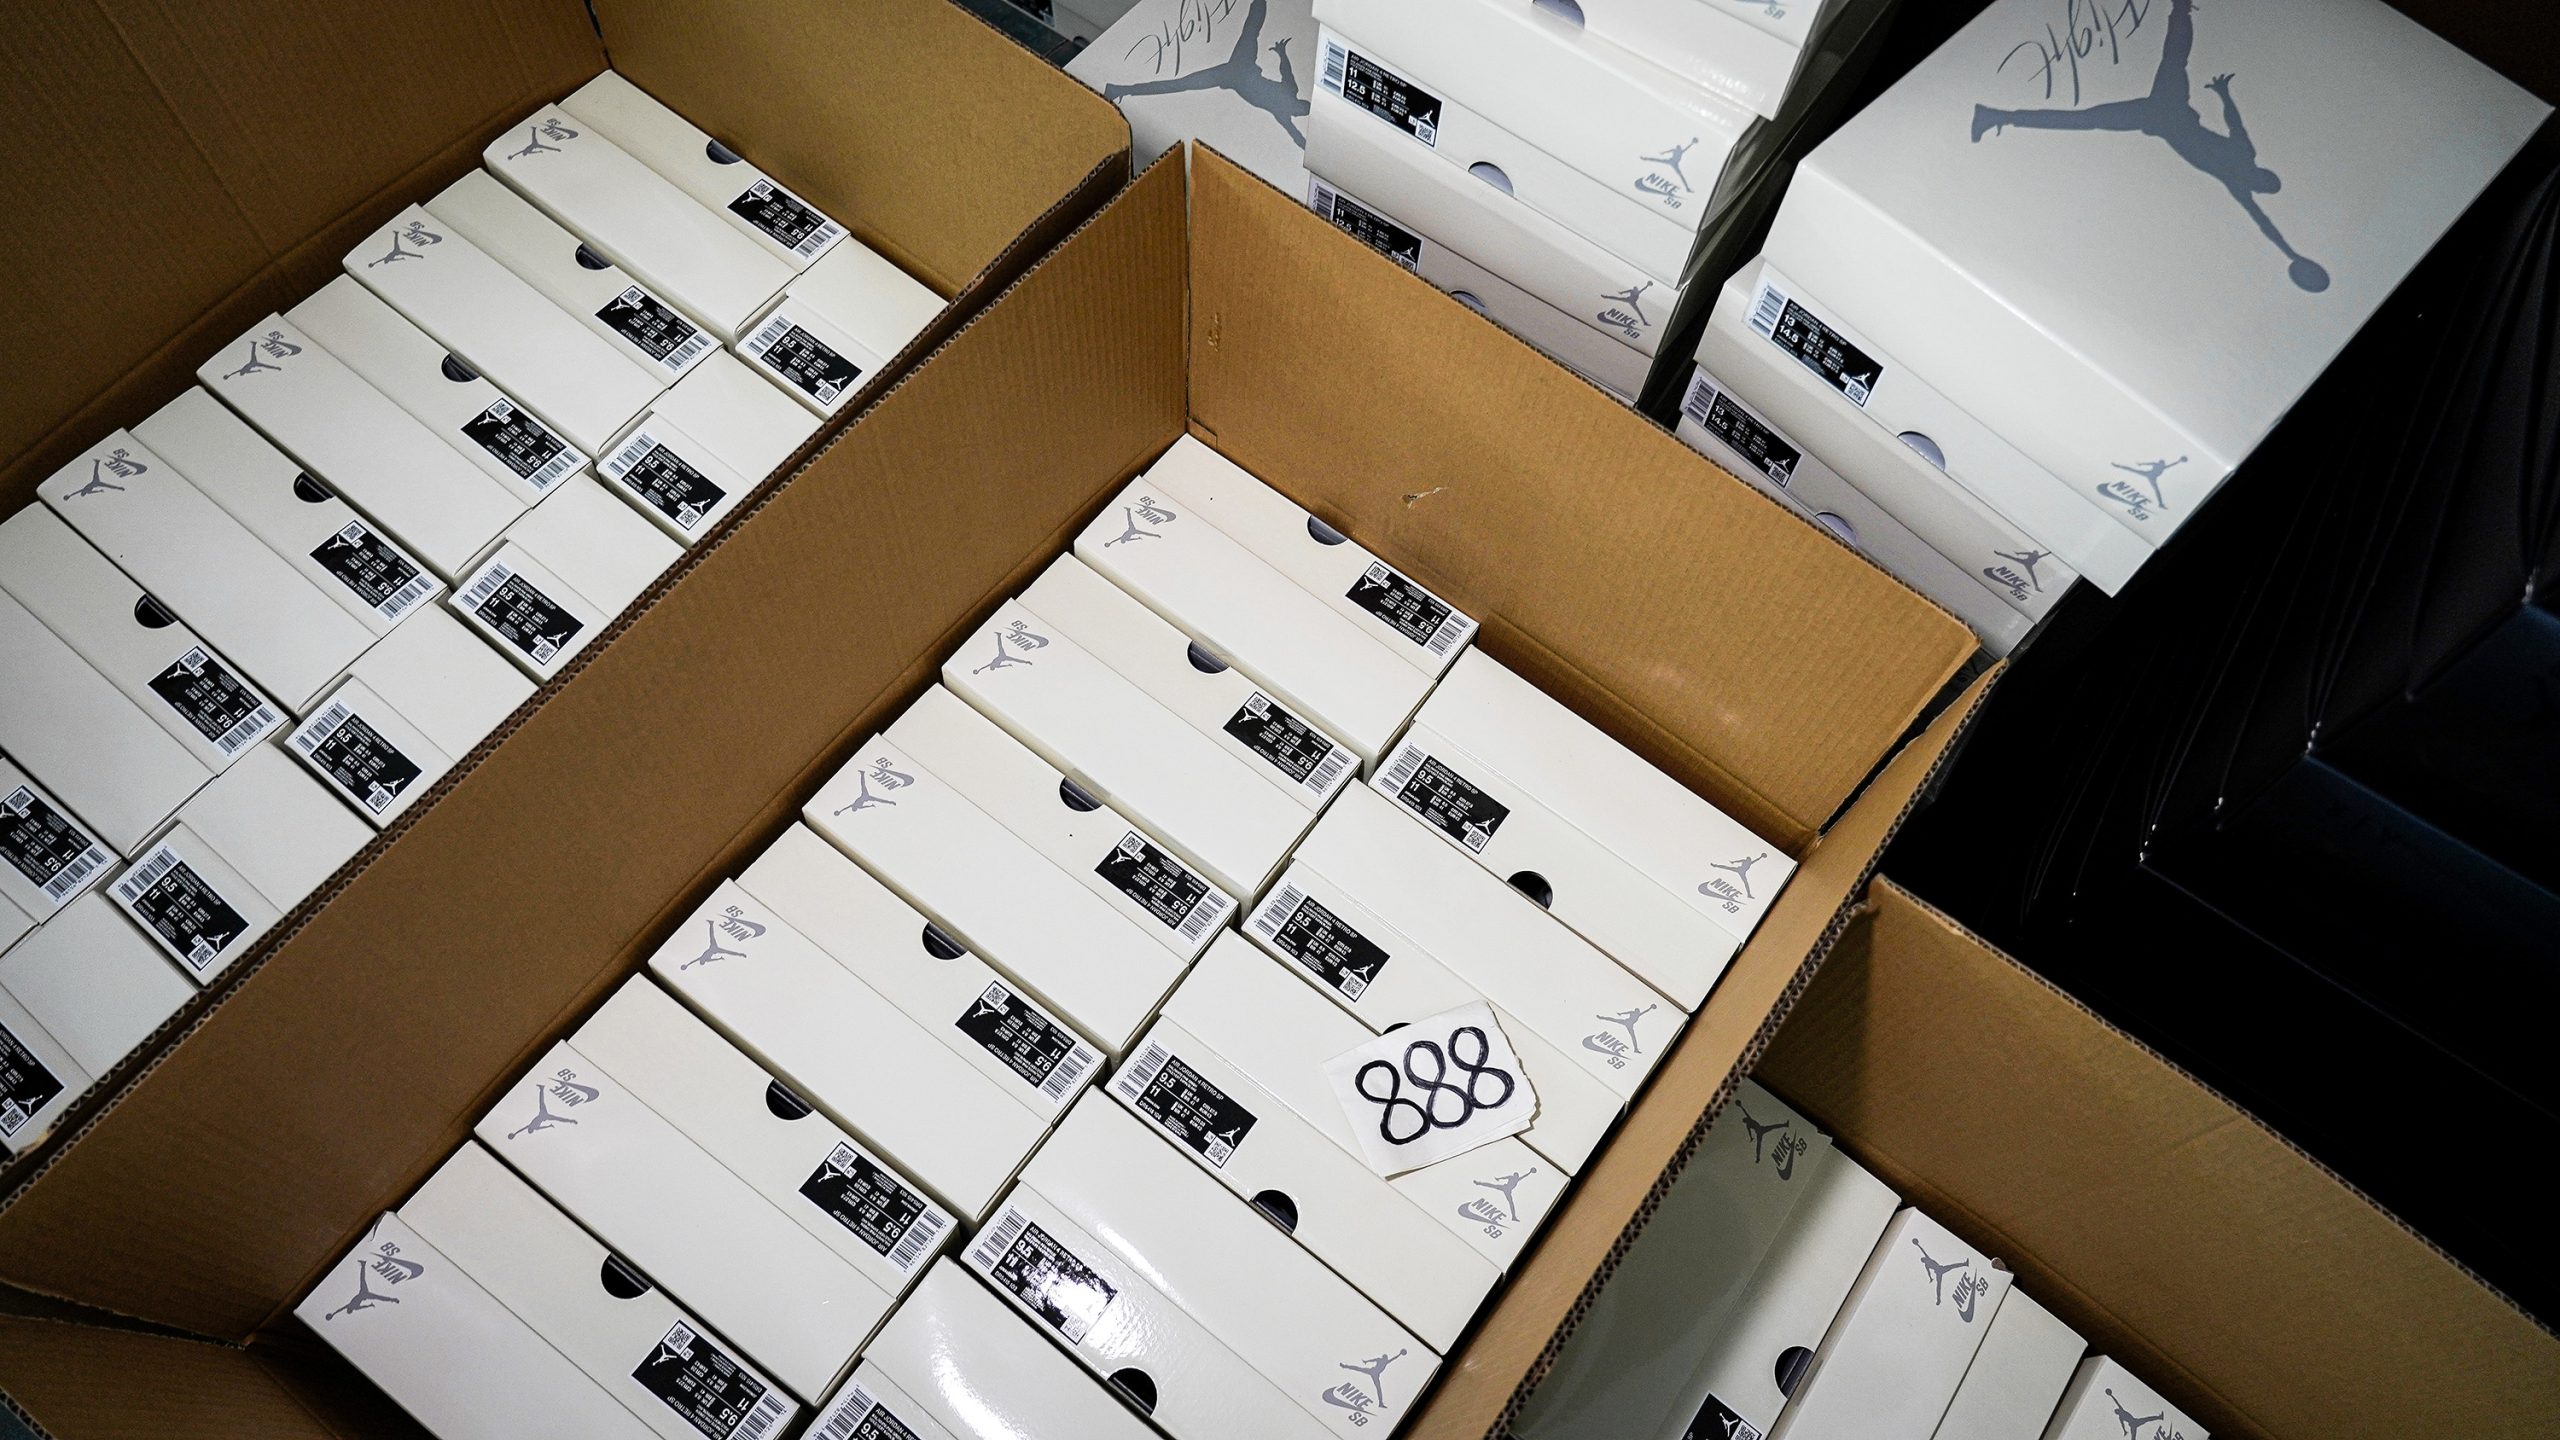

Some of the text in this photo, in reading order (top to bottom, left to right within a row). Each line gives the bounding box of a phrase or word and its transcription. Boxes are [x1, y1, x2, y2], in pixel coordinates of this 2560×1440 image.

[1349, 66, 1358, 78] 11
[1347, 78, 1366, 95] 12.5
[540, 127, 570, 141] NIKE
[1645, 173, 1679, 194] NIKE
[1336, 208, 1345, 218] 11
[790, 228, 805, 240] 9.5
[803, 223, 814, 232] 11
[402, 231, 430, 246] NIKE
[1606, 308, 1638, 327] NIKE
[1784, 313, 1796, 327] 13
[268, 331, 284, 340] SB
[673, 333, 684, 343] 11
[1623, 328, 1640, 339] SB
[1779, 324, 1799, 343] 14.5
[659, 338, 675, 351] 9.5
[773, 344, 783, 354] 11
[781, 335, 797, 348] 9.5
[260, 342, 289, 358] NIKE
[1715, 404, 1725, 416] 13
[1711, 413, 1728, 430] 14.5
[113, 448, 129, 459] SB
[541, 449, 552, 459] 11
[104, 460, 134, 478] NIKE
[526, 455, 542, 468] 9.5
[644, 455, 660, 469] 9.5
[634, 464, 646, 475] 11
[1139, 495, 1155, 507] SB
[2111, 481, 2151, 508] NIKE
[1134, 506, 1165, 525] NIKE
[392, 576, 405, 586] 11
[1995, 566, 2030, 589] NIKE
[377, 581, 393, 596] 9.5
[498, 586, 515, 601] 9.5
[2009, 589, 2027, 601] SB
[489, 597, 500, 608] 11
[1011, 620, 1028, 631] SB
[1417, 620, 1434, 634] 9.5
[1430, 614, 1441, 625] 11
[1005, 631, 1036, 651] NIKE
[233, 707, 245, 718] 11
[216, 713, 233, 729] 9.5
[336, 727, 352, 743] 9.5
[325, 739, 337, 750] 11
[876, 757, 893, 768] SB
[1310, 750, 1321, 760] 11
[1297, 756, 1314, 770] 9.5
[870, 771, 900, 790] NIKE
[1417, 769, 1434, 784] 9.5
[1409, 780, 1420, 792] 11
[61, 849, 75, 860] 11
[44, 856, 62, 872] 9.5
[161, 876, 178, 892] 9.5
[1710, 878, 1743, 898] NIKE
[148, 888, 161, 900] 11
[1131, 891, 1148, 906] RETRO
[1185, 892, 1197, 904] 11
[725, 905, 743, 917] SB
[1149, 904, 1169, 920] JORDAN
[1171, 900, 1188, 915] 9.5
[1721, 901, 1739, 914] SB
[1166, 917, 1177, 926] AIR
[1294, 911, 1312, 927] 9.5
[1305, 899, 1316, 908] AIR
[1313, 905, 1334, 921] JORDAN
[1334, 920, 1352, 935] RETRO
[719, 921, 751, 942] NIKE
[1286, 923, 1297, 935] 11
[1595, 1031, 1629, 1053] NIKE
[993, 1046, 1011, 1062] RETRO
[1049, 1047, 1062, 1060] 11
[1011, 1061, 1032, 1078] JORDAN
[1034, 1055, 1052, 1072] 9.5
[1607, 1056, 1625, 1069] SB
[557, 1068, 577, 1081] SB
[1029, 1074, 1040, 1084] AIR
[1158, 1071, 1176, 1089] 9.5
[1170, 1059, 1181, 1068] AIR
[1178, 1065, 1199, 1082] JORDAN
[1200, 1080, 1218, 1096] RETRO
[1215, 1092, 1224, 1100] SP
[1149, 1084, 1161, 1097] 11
[1355, 1026, 1515, 1145] 888
[550, 1084, 584, 1107] NIKE
[1771, 1132, 1791, 1167] NIKE
[1794, 1137, 1807, 1157] SB
[832, 1209, 842, 1217] SP
[1471, 1198, 1507, 1221] NIKE
[839, 1214, 858, 1230] RETRO
[899, 1212, 911, 1225] 11
[858, 1228, 880, 1245] JORDAN
[882, 1221, 901, 1239] 9.5
[1483, 1225, 1503, 1239] SB
[380, 1241, 400, 1256] SB
[877, 1242, 888, 1252] AIR
[1015, 1239, 1034, 1259] 9.5
[371, 1260, 407, 1285] NIKE
[1952, 1271, 1972, 1308] NIKE
[1975, 1277, 1989, 1297] SB
[666, 1395, 676, 1404] SP
[1337, 1382, 1373, 1408] NIKE
[673, 1400, 692, 1417] RETRO
[736, 1397, 750, 1411] 11
[718, 1407, 738, 1426] 9.5
[874, 1407, 886, 1418] AIR
[883, 1415, 905, 1434] JORDAN
[1348, 1411, 1368, 1427] SB
[693, 1415, 715, 1434] JORDAN
[860, 1422, 880, 1440] 9.5
